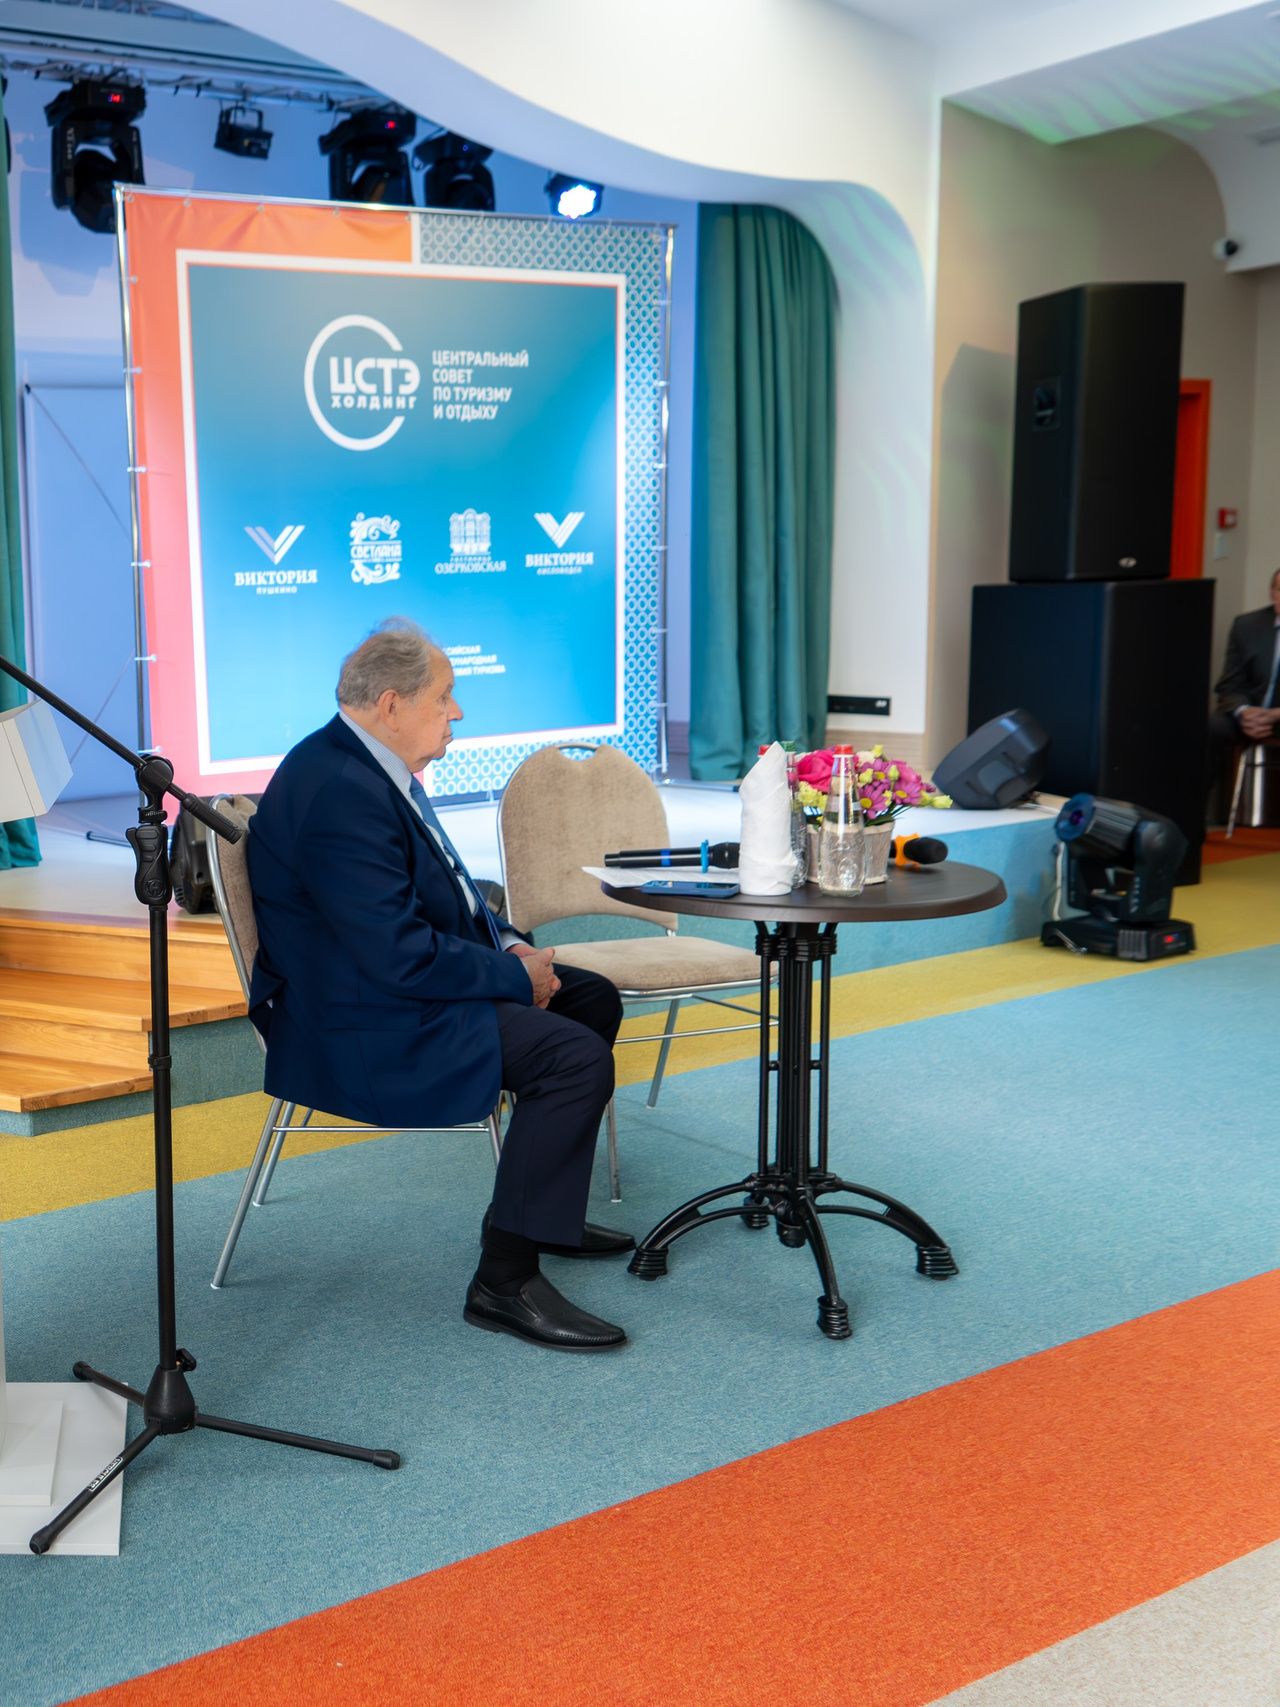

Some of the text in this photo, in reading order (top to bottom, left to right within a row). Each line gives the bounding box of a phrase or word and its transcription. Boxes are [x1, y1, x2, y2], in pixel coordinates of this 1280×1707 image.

[432, 349, 529, 367] ЦЕНТРАЛЬНЫЙ
[329, 356, 420, 395] ЦСТЭ
[432, 368, 474, 384] СОВЕТ
[331, 395, 417, 410] ХОЛДИНГ
[433, 386, 513, 403] ПО ТУРИЗМУ
[433, 404, 499, 423] И ОТДЫХУ
[525, 551, 594, 567] ВИКТОРИЯ
[234, 569, 318, 587] ВИКТОРИЯ
[256, 586, 298, 595] ПУШКИНО
